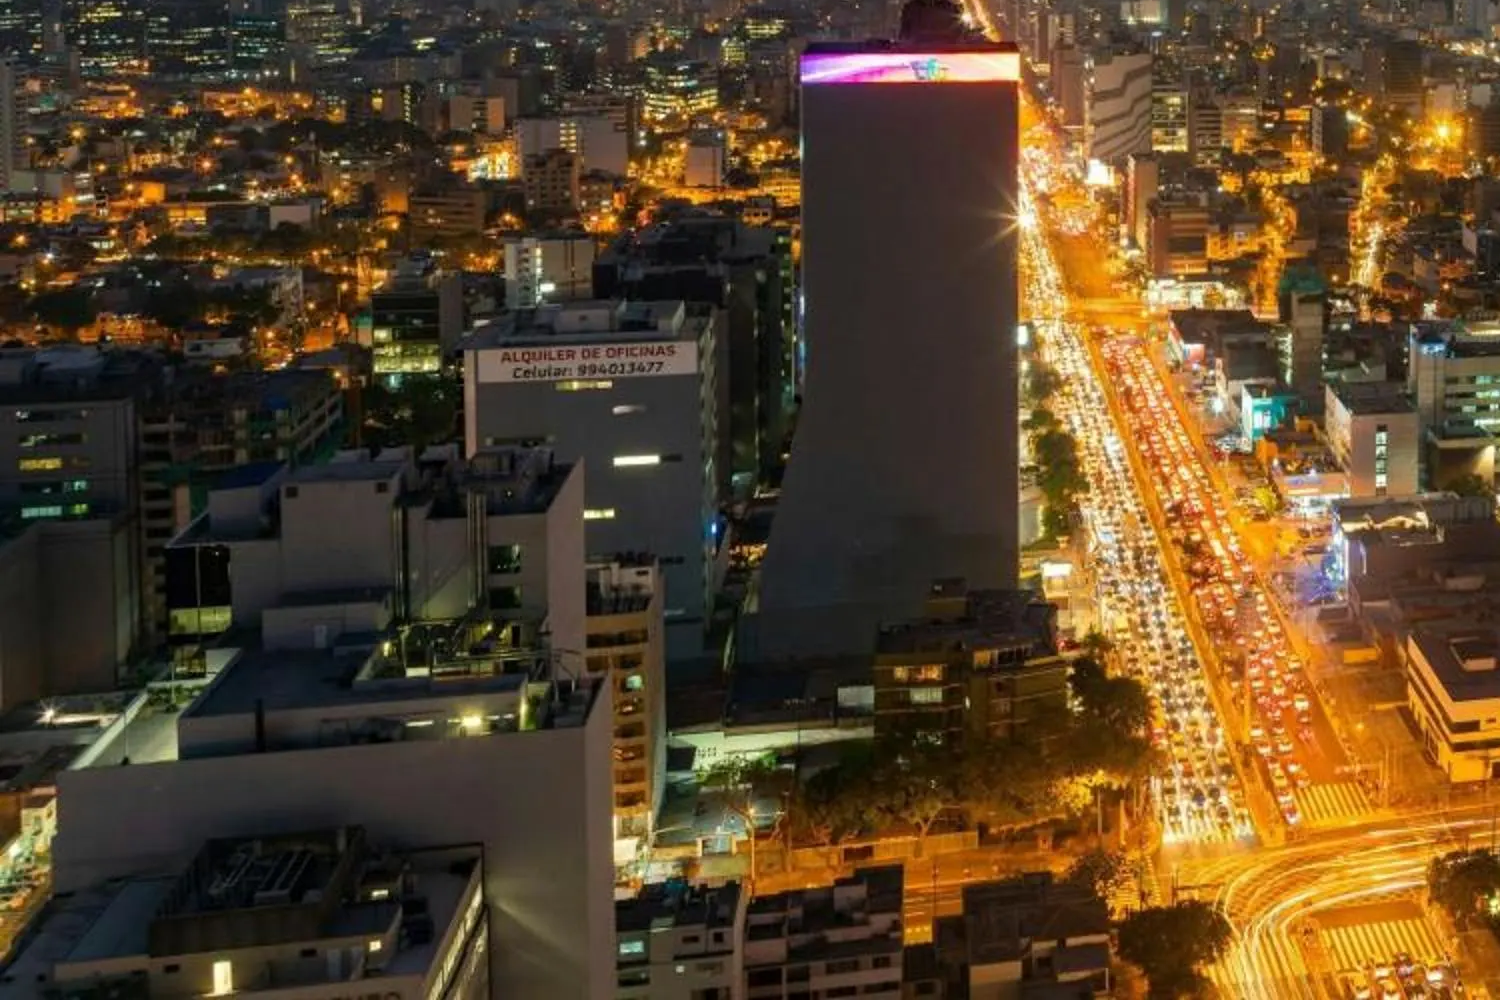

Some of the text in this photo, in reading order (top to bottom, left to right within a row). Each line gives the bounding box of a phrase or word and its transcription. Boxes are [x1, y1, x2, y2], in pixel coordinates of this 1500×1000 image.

[501, 344, 676, 364] ALQUILER DE OFICINAS
[512, 364, 573, 379] Celular:
